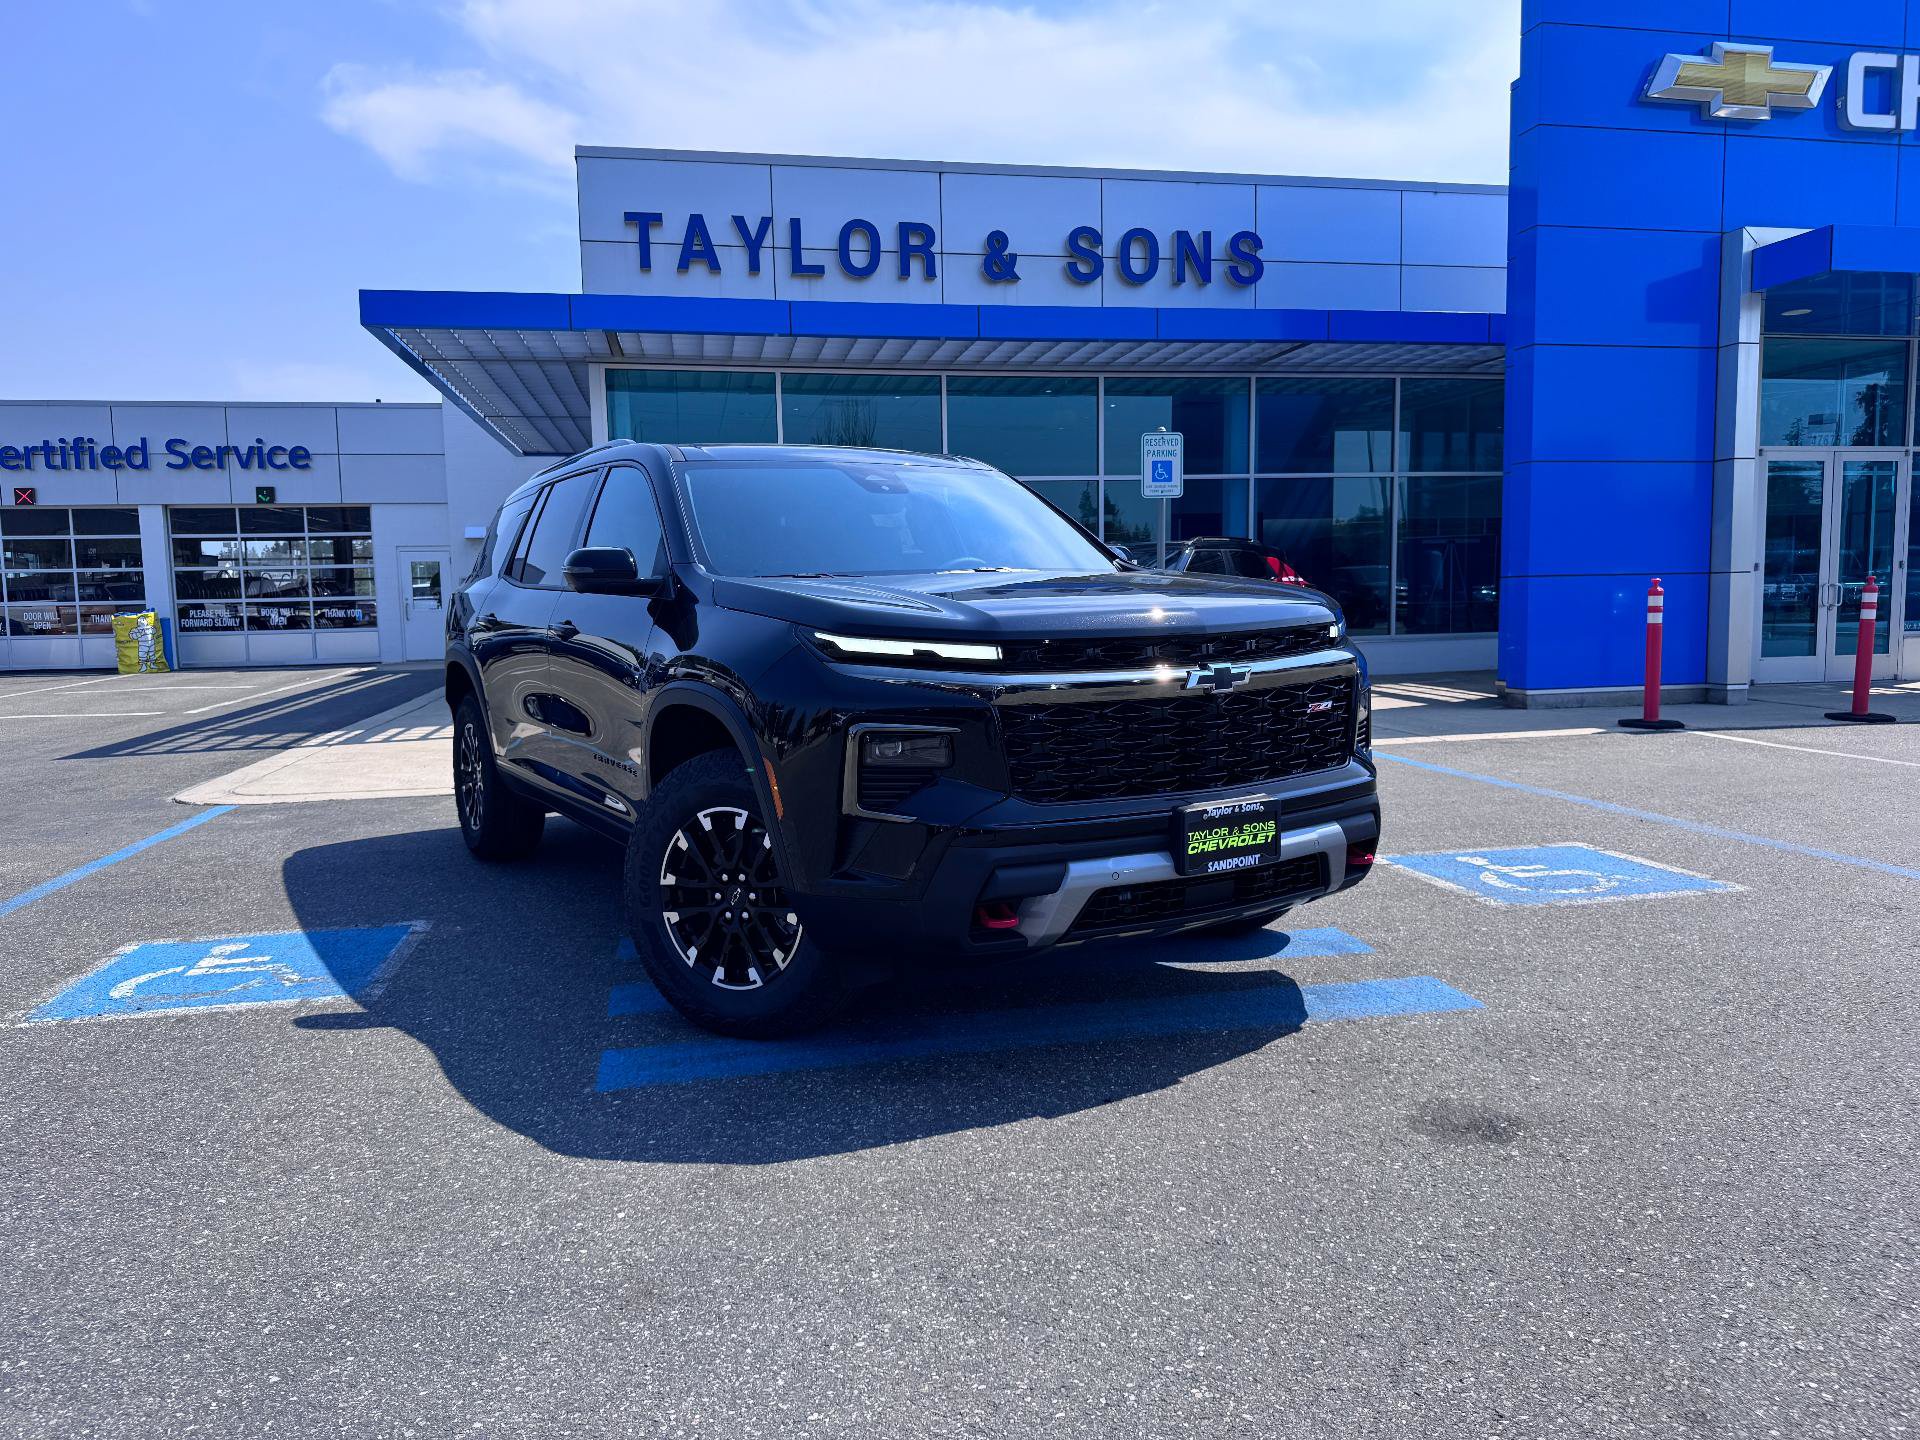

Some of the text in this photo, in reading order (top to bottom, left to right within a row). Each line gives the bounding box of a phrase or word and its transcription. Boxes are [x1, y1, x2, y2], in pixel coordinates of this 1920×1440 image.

[624, 211, 1266, 287] TAYLOR & SONS
[1145, 438, 1179, 447] RESERVED
[0, 437, 312, 471] ertified Service
[1146, 449, 1177, 457] PARKING
[23, 612, 42, 621] DOOR
[189, 609, 214, 619] PLEASE
[325, 608, 345, 618] THANK
[33, 621, 52, 630] OPEN
[181, 617, 240, 628] FORWARD SLOWLY
[1206, 805, 1233, 818] Taylor
[1241, 803, 1261, 813] Sons
[1187, 820, 1276, 841] TAYLOR & SONS
[1187, 831, 1276, 855] CHEVROLET
[1207, 854, 1261, 872] SANDPOINT
